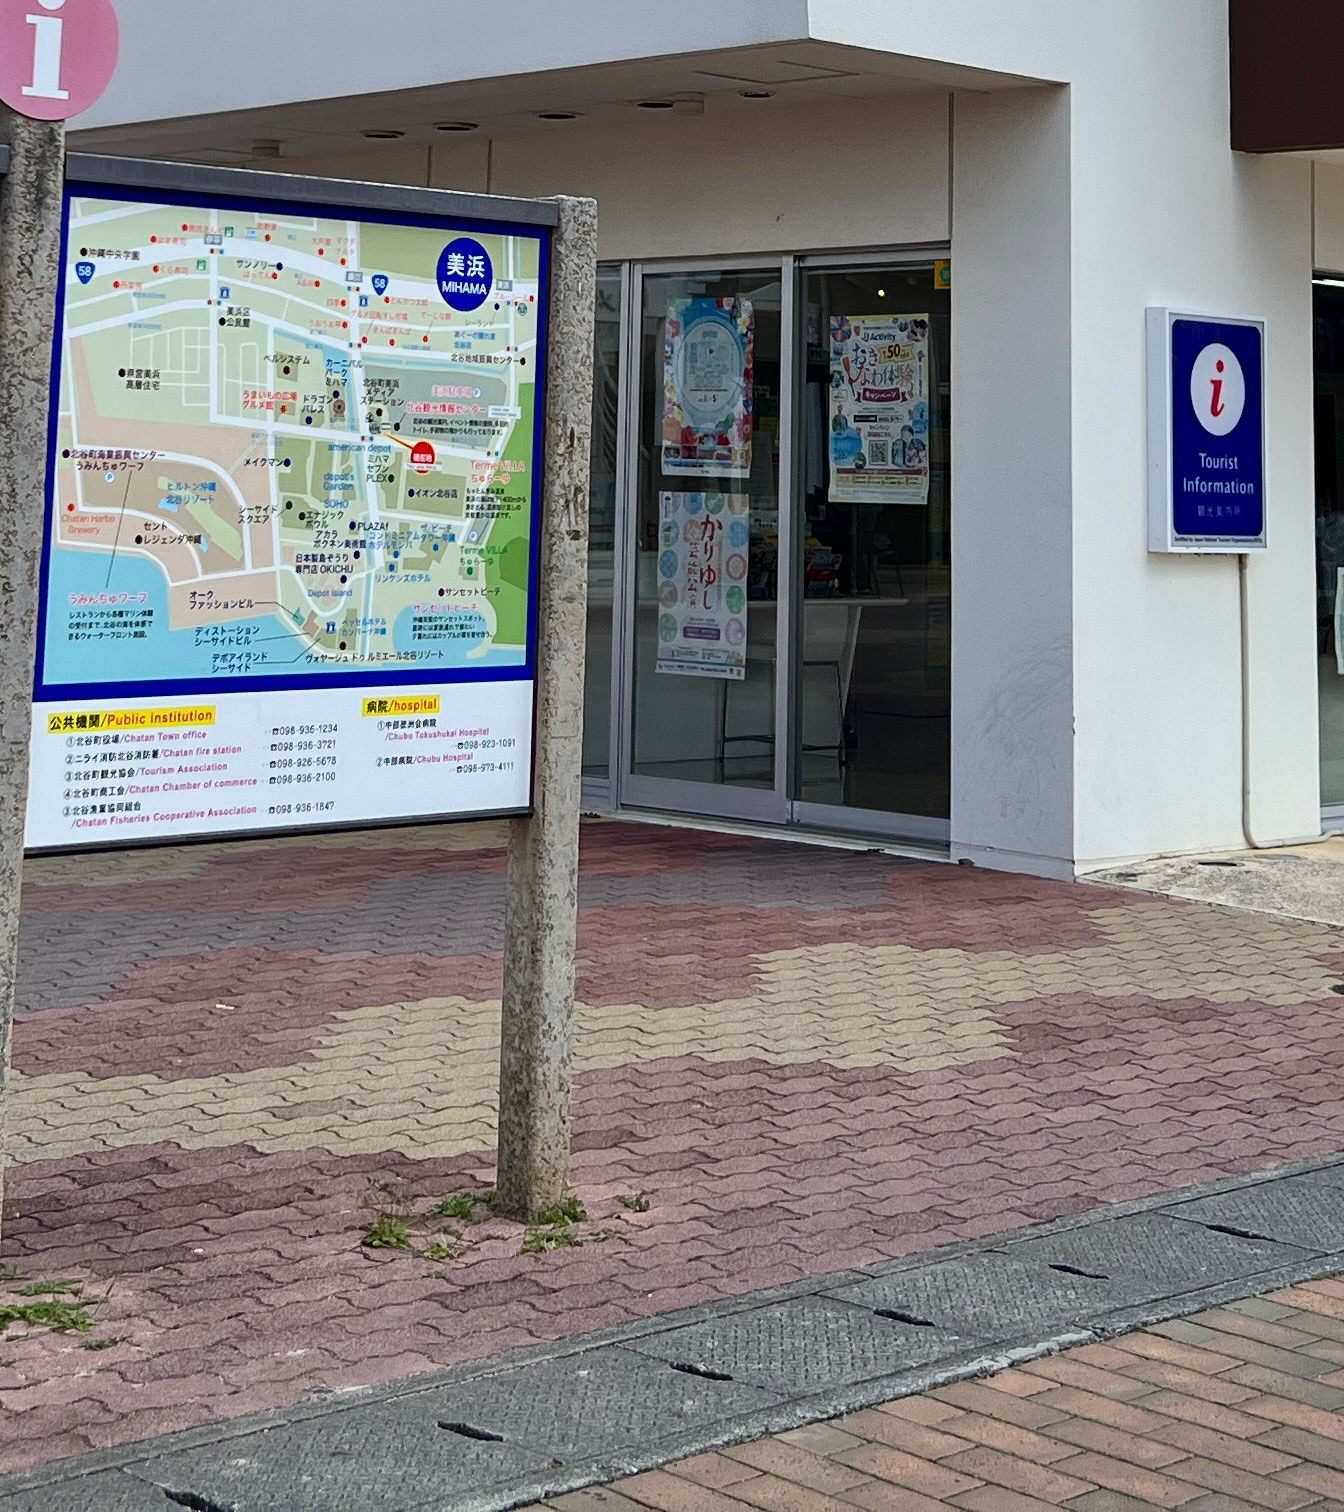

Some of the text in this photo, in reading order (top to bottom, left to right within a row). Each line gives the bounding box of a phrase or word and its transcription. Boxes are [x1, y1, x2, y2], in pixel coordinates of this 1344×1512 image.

[447, 253, 485, 277] 美浜
[78, 266, 92, 276] 58
[375, 279, 385, 288] 58
[442, 281, 487, 295] MIHAMA
[328, 444, 392, 453] american depot
[244, 459, 284, 467] メイクマン
[470, 461, 497, 471] Terme
[1199, 453, 1239, 470] Tourist
[76, 462, 144, 471] うみんちゅワーフ
[367, 474, 387, 482] PLEX
[1183, 477, 1254, 495] Information
[416, 489, 457, 498] イオン北谷店
[324, 500, 348, 508] SOHO
[239, 506, 277, 514] シーサイド
[238, 515, 269, 524] スクエア
[306, 511, 343, 519] エナジック
[68, 526, 100, 535] Brewery
[144, 522, 167, 530] セント
[316, 530, 338, 538] アカラ
[314, 540, 366, 548] ボクネン美術館
[700, 514, 723, 611] かりゆし
[296, 565, 352, 573] 専門店 OKICHU
[190, 591, 213, 599] オーク
[308, 589, 329, 597] Depot
[446, 588, 500, 597] サンセットビーチ
[69, 593, 148, 605] うみんちゅワーフ
[190, 601, 253, 609] ファッションビル
[196, 626, 260, 636] ディストーション
[195, 638, 251, 646] シーサイドビル
[212, 653, 267, 662] デポアイランド
[212, 663, 251, 672] シーサイド
[150, 710, 212, 724] institution
[158, 731, 180, 740] Town
[183, 730, 207, 739] office
[459, 728, 489, 737] Hospital
[196, 747, 210, 755] fire
[213, 745, 242, 754] station
[443, 753, 473, 763] Hospital
[177, 762, 227, 773] Association
[163, 781, 200, 791] Chamber
[204, 780, 212, 788] of
[214, 778, 257, 787] commerce
[110, 815, 150, 825] Fisheries
[153, 810, 205, 822] Cooperative
[208, 806, 257, 817] Association
